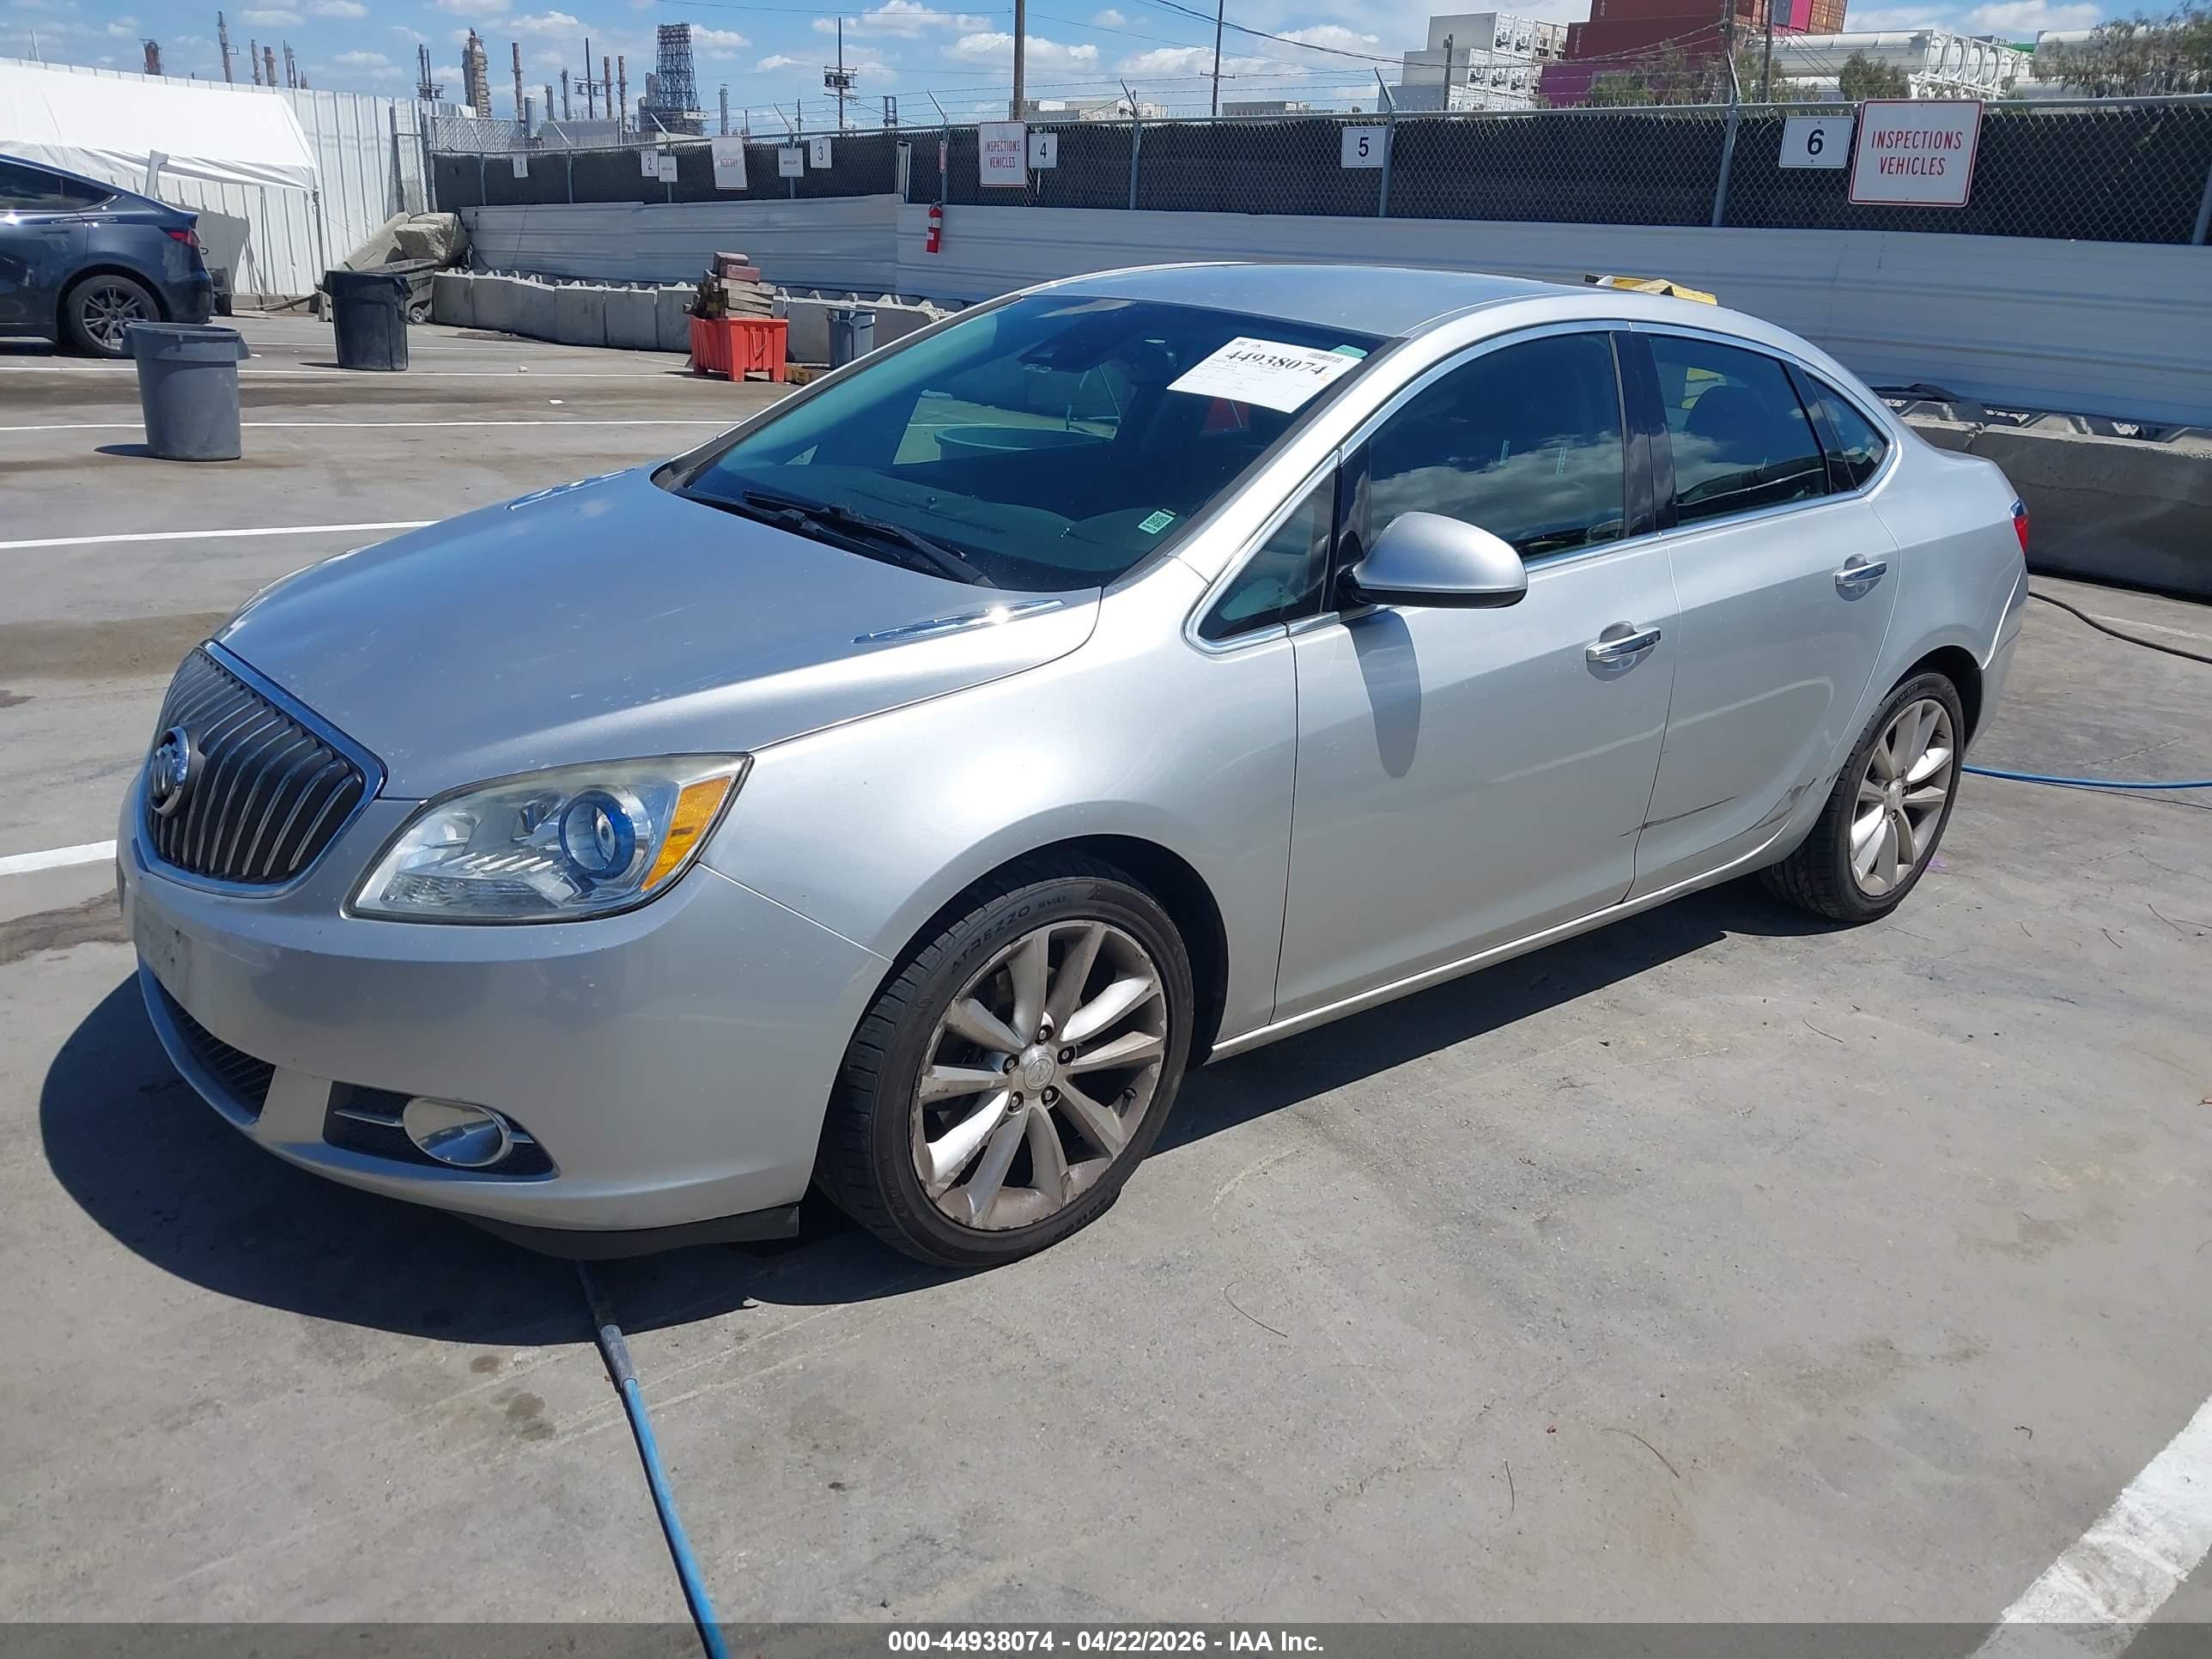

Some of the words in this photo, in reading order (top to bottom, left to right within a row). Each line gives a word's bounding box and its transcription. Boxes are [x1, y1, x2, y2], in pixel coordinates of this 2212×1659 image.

[984, 139, 1021, 153] INSPECTIONS
[1358, 137, 1370, 157] 5
[1807, 129, 1825, 155] 6
[1871, 130, 1963, 149] INSPECTIONS
[817, 145, 824, 161] 3
[1039, 142, 1048, 160] 4
[647, 157, 653, 171] 2
[988, 156, 1016, 168] VEHICLES
[1879, 156, 1946, 176] VEHICLES
[1224, 349, 1328, 375] 44938074
[951, 906, 1030, 974] ATREZZO
